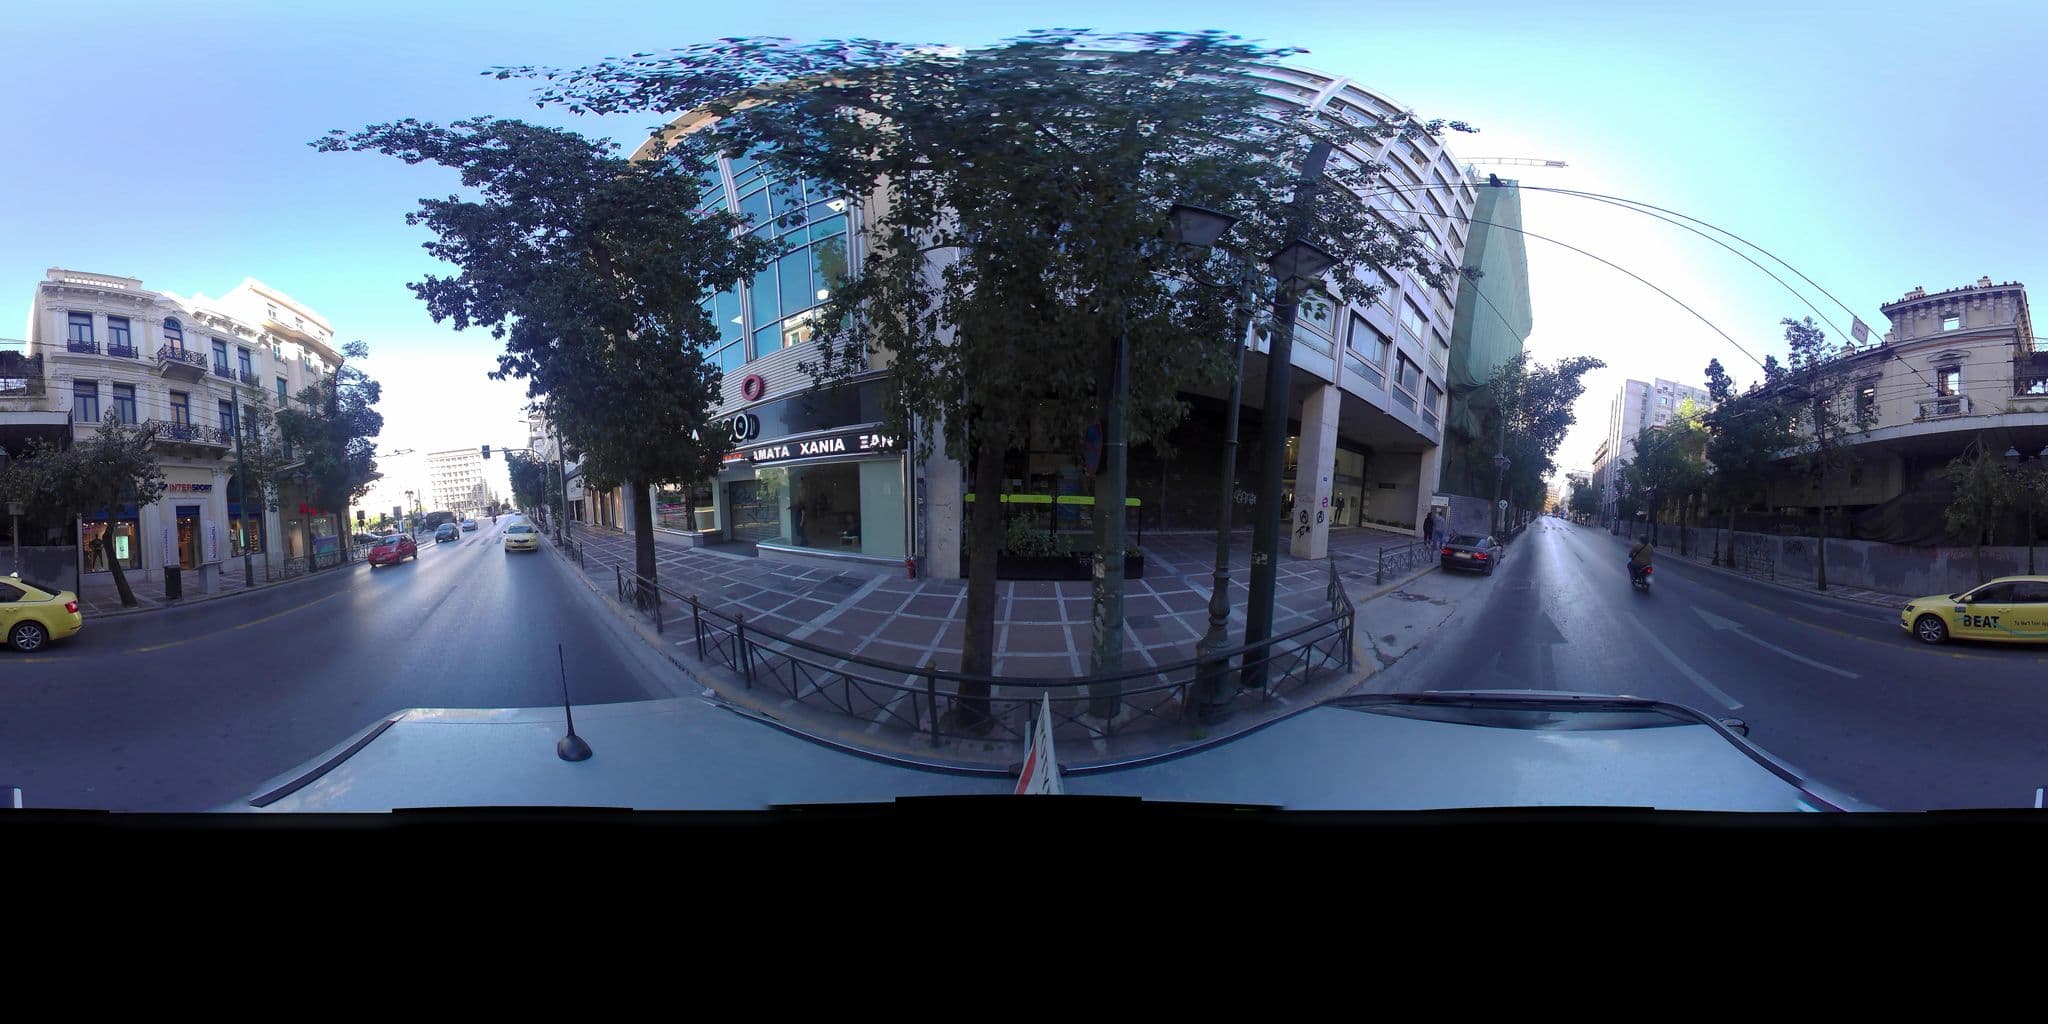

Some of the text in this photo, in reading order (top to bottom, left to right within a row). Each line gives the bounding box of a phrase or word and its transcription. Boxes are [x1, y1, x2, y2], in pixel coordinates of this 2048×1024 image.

[800, 438, 846, 455] ΧΑΝΙΑ
[859, 434, 900, 450] ΞΑΝ
[169, 483, 212, 492] INTERSPORT
[1963, 615, 2000, 629] BEAT
